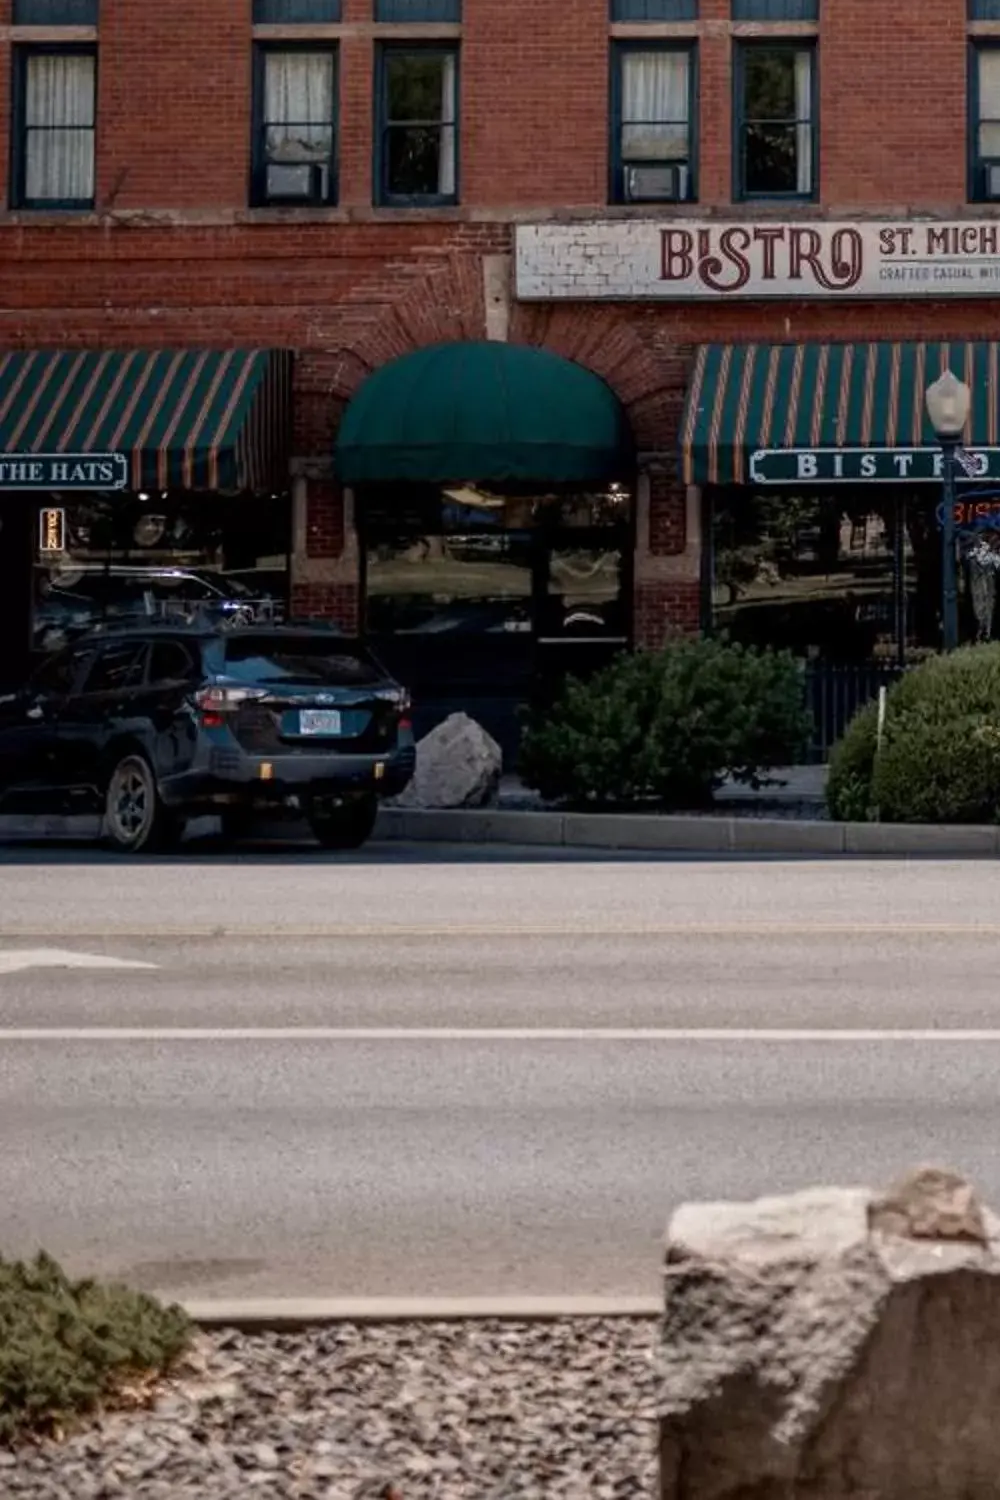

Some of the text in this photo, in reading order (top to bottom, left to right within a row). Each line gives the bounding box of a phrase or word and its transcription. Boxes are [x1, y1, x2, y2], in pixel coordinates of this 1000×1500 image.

[879, 227, 917, 255] ST.
[659, 227, 863, 292] BISTRO
[879, 267, 929, 281] CRAFTED
[933, 267, 973, 280] CASUAL
[51, 463, 113, 481] HATS
